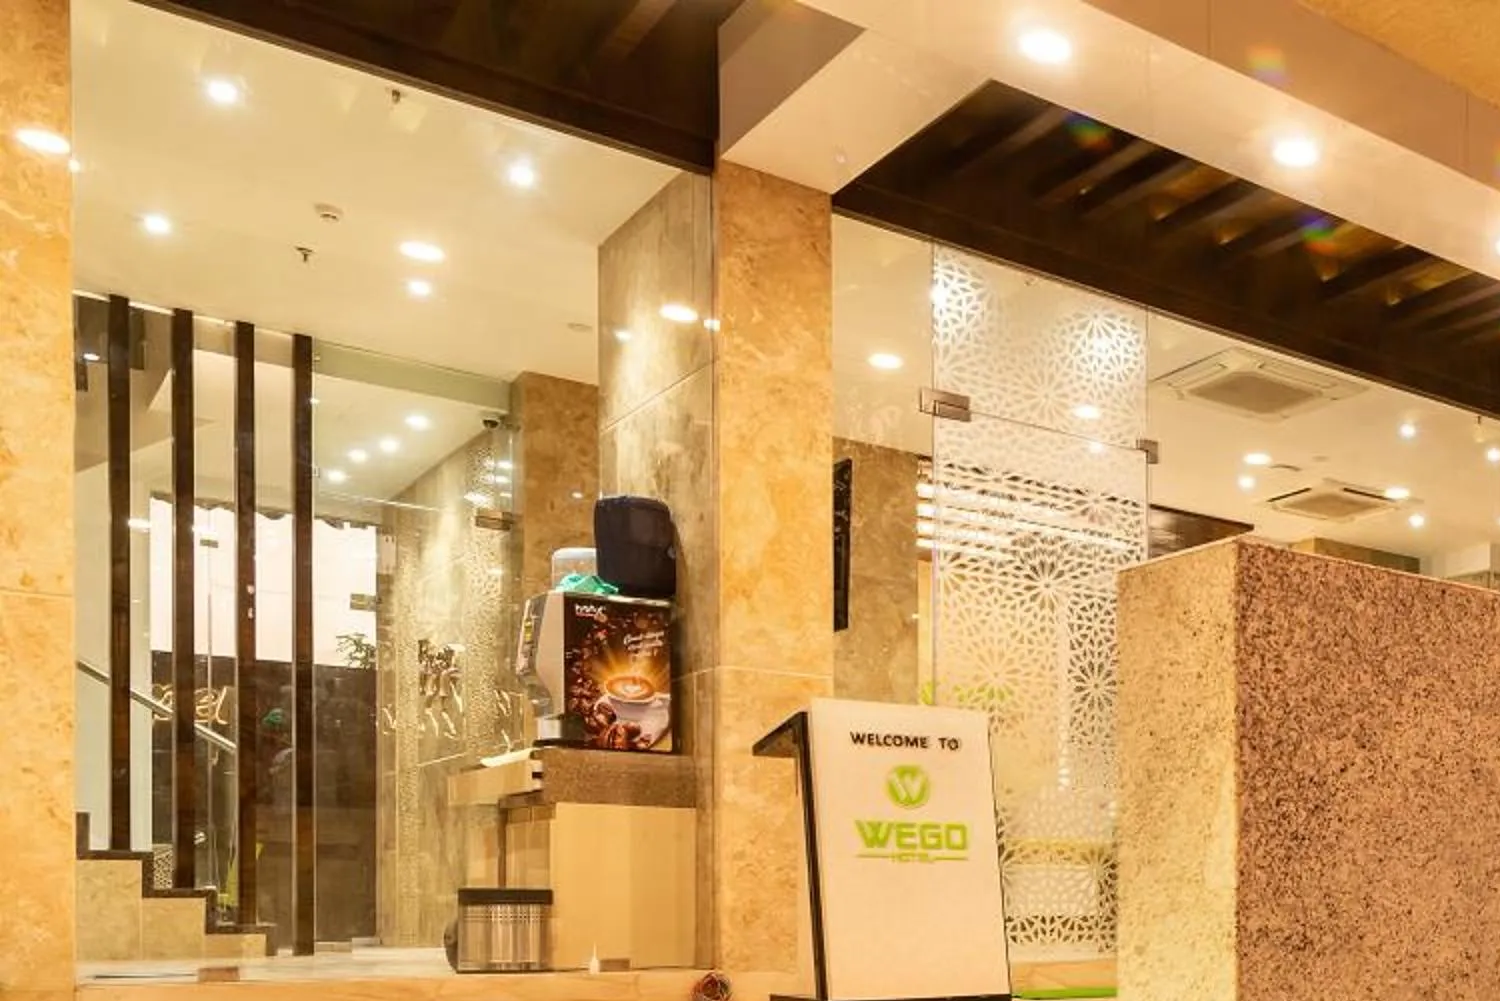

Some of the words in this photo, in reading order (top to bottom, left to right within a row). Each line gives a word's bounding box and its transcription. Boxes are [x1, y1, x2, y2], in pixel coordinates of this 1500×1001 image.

[850, 732, 928, 749] WELCOME
[938, 737, 960, 751] TO
[855, 820, 968, 851] WEGO
